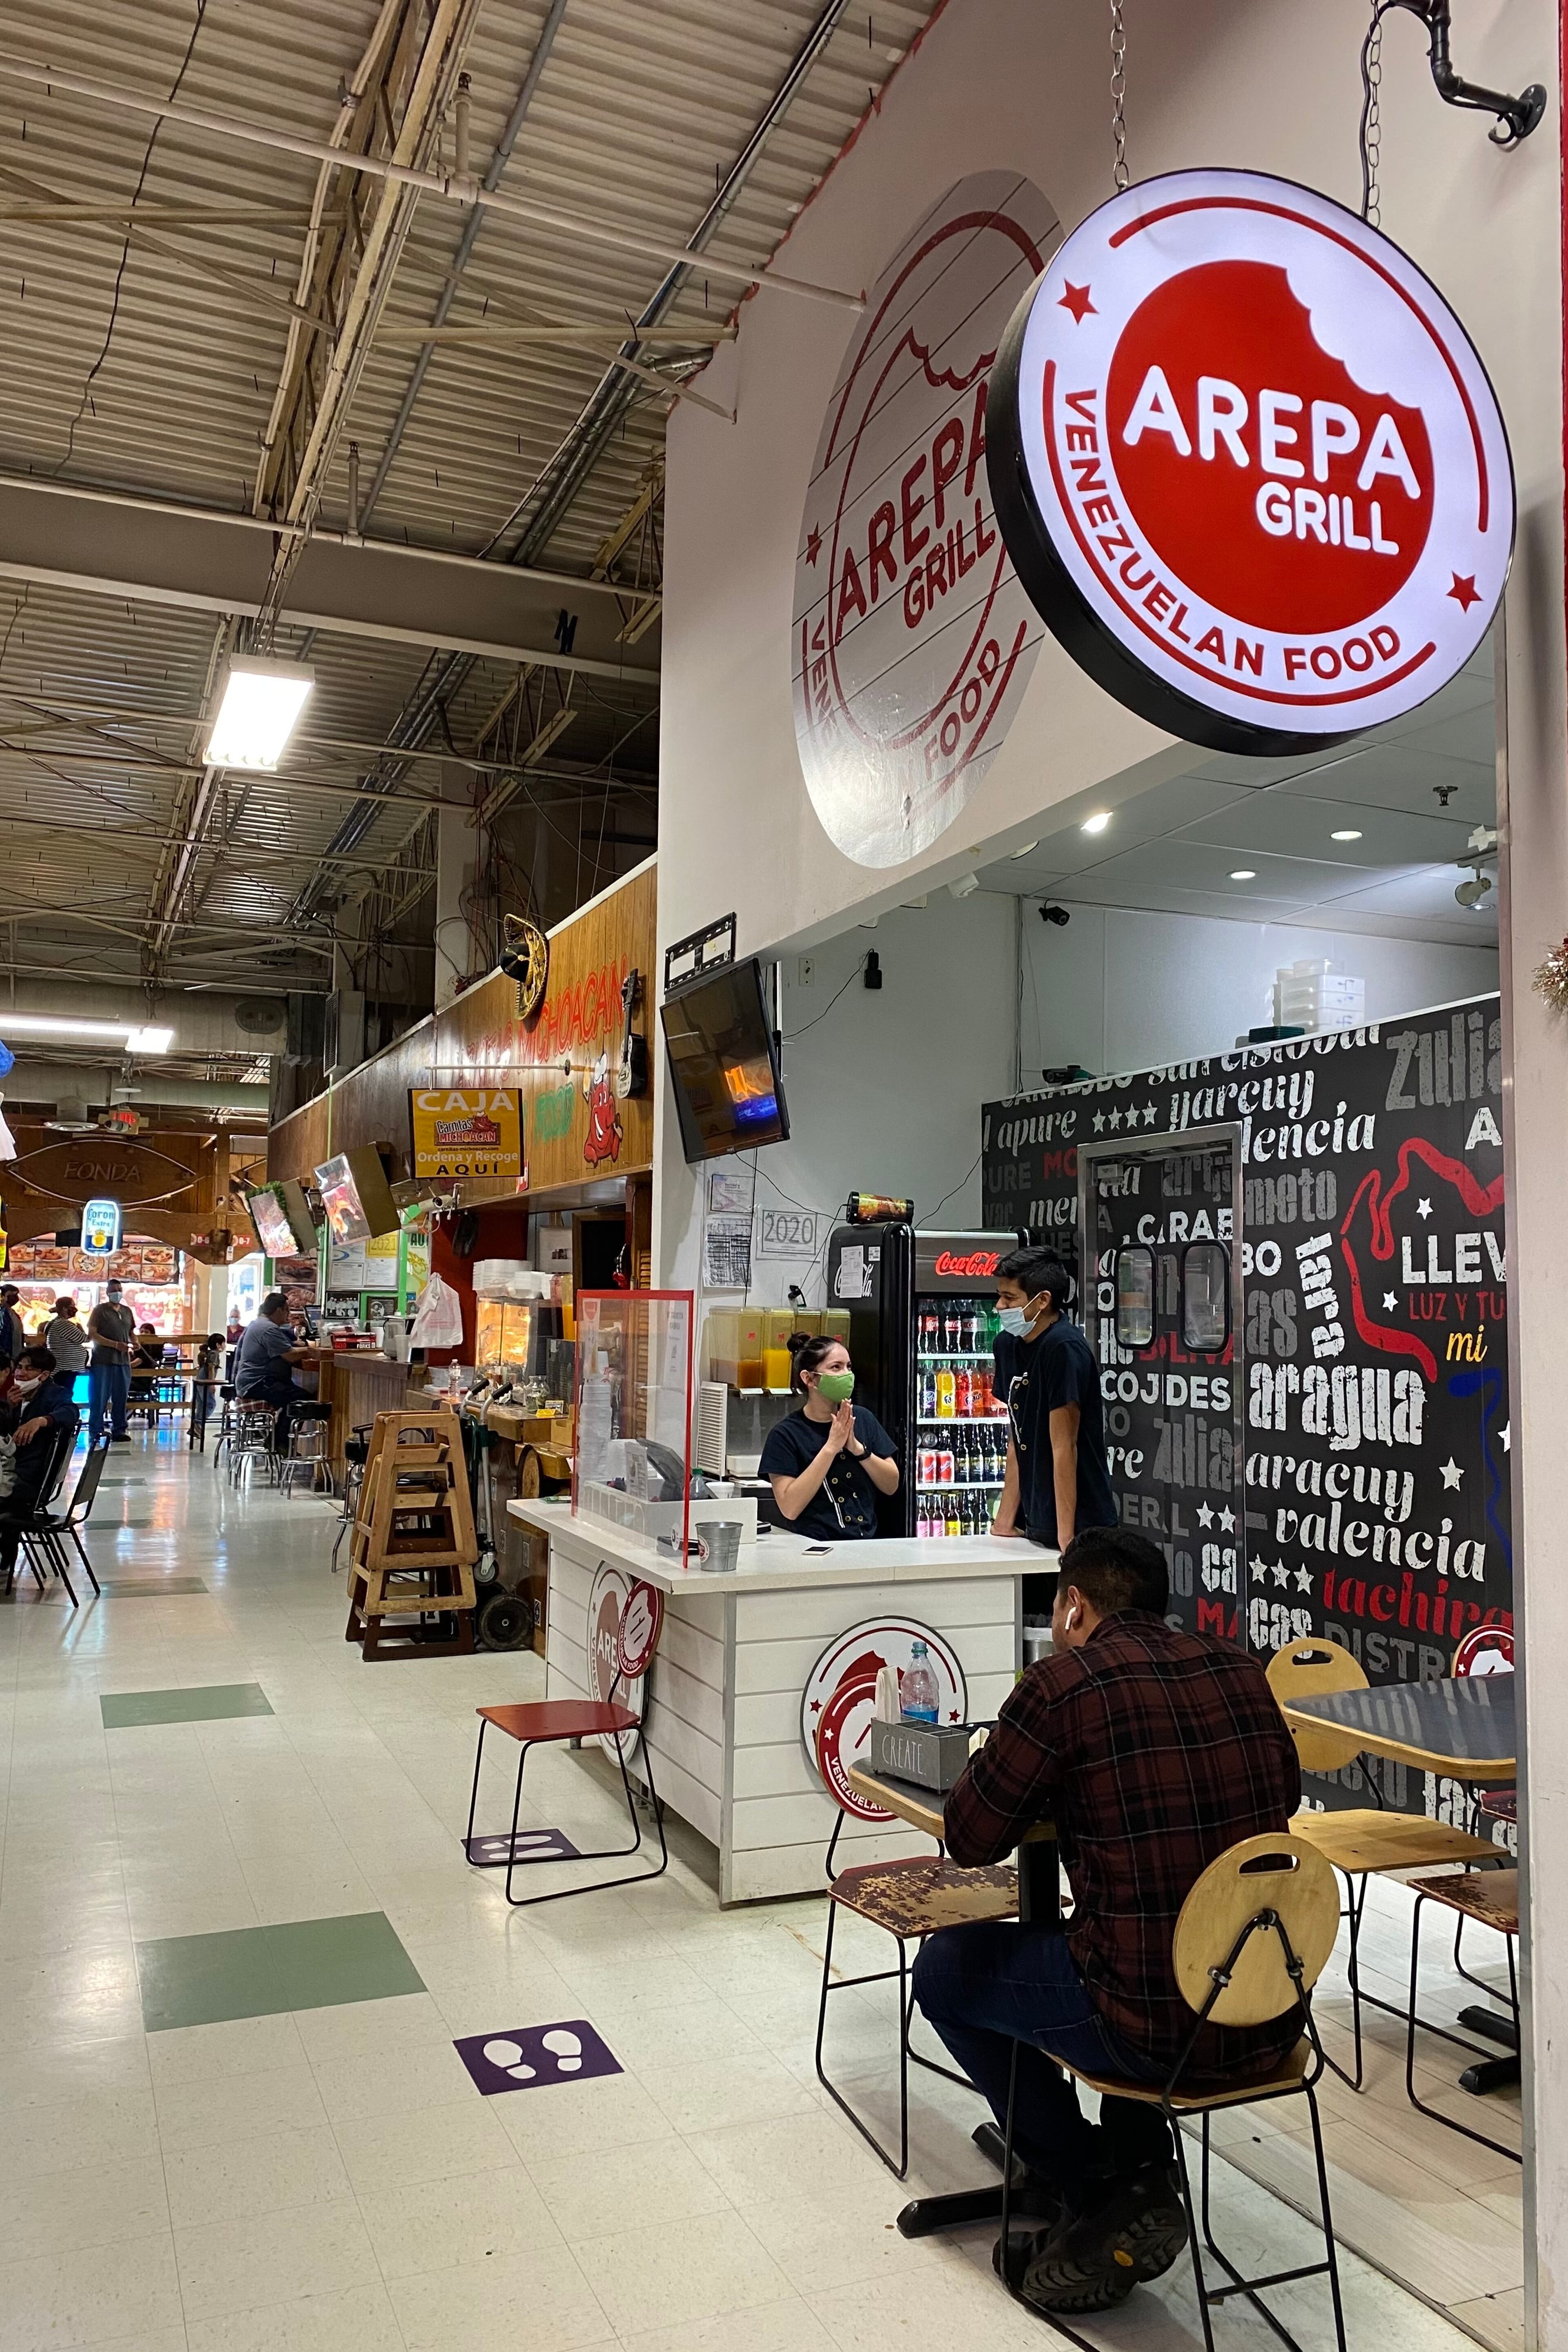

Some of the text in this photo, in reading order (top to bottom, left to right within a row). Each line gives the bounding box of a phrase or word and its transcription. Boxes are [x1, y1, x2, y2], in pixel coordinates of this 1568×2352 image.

[1123, 365, 1421, 499] AREPA
[835, 380, 987, 646] AREPA
[1256, 481, 1399, 555] GRILL
[1065, 389, 1401, 680] VENEZUELAN FOOD
[904, 498, 995, 628] GRILL
[924, 639, 1000, 780] FOOD
[417, 1092, 514, 1111] CAJA
[437, 1118, 472, 1134] Carnitas
[439, 1131, 497, 1143] MICHOACAN
[997, 1108, 1077, 1156] apure
[64, 1162, 141, 1182] FONDA
[417, 1152, 518, 1164] Ordena y Recoge
[436, 1161, 499, 1176] AQUÍ
[87, 1208, 114, 1221] Coron
[764, 1214, 814, 1244] 2020
[1137, 1208, 1233, 1245] CRAB
[371, 1237, 396, 1251] 2021
[410, 1233, 428, 1246] AU
[935, 1251, 1000, 1276] Coca-Cola
[1409, 1292, 1447, 1321] LUZ
[1454, 1293, 1468, 1321] Y
[1446, 1325, 1488, 1362] mi
[1100, 1370, 1232, 1412] COJDES
[1249, 1362, 1428, 1451] aragua
[1245, 1448, 1414, 1523] aracuy
[1275, 1500, 1487, 1583] valencia
[1323, 1566, 1513, 1640] tachira
[882, 1734, 927, 1776] CREATE.
